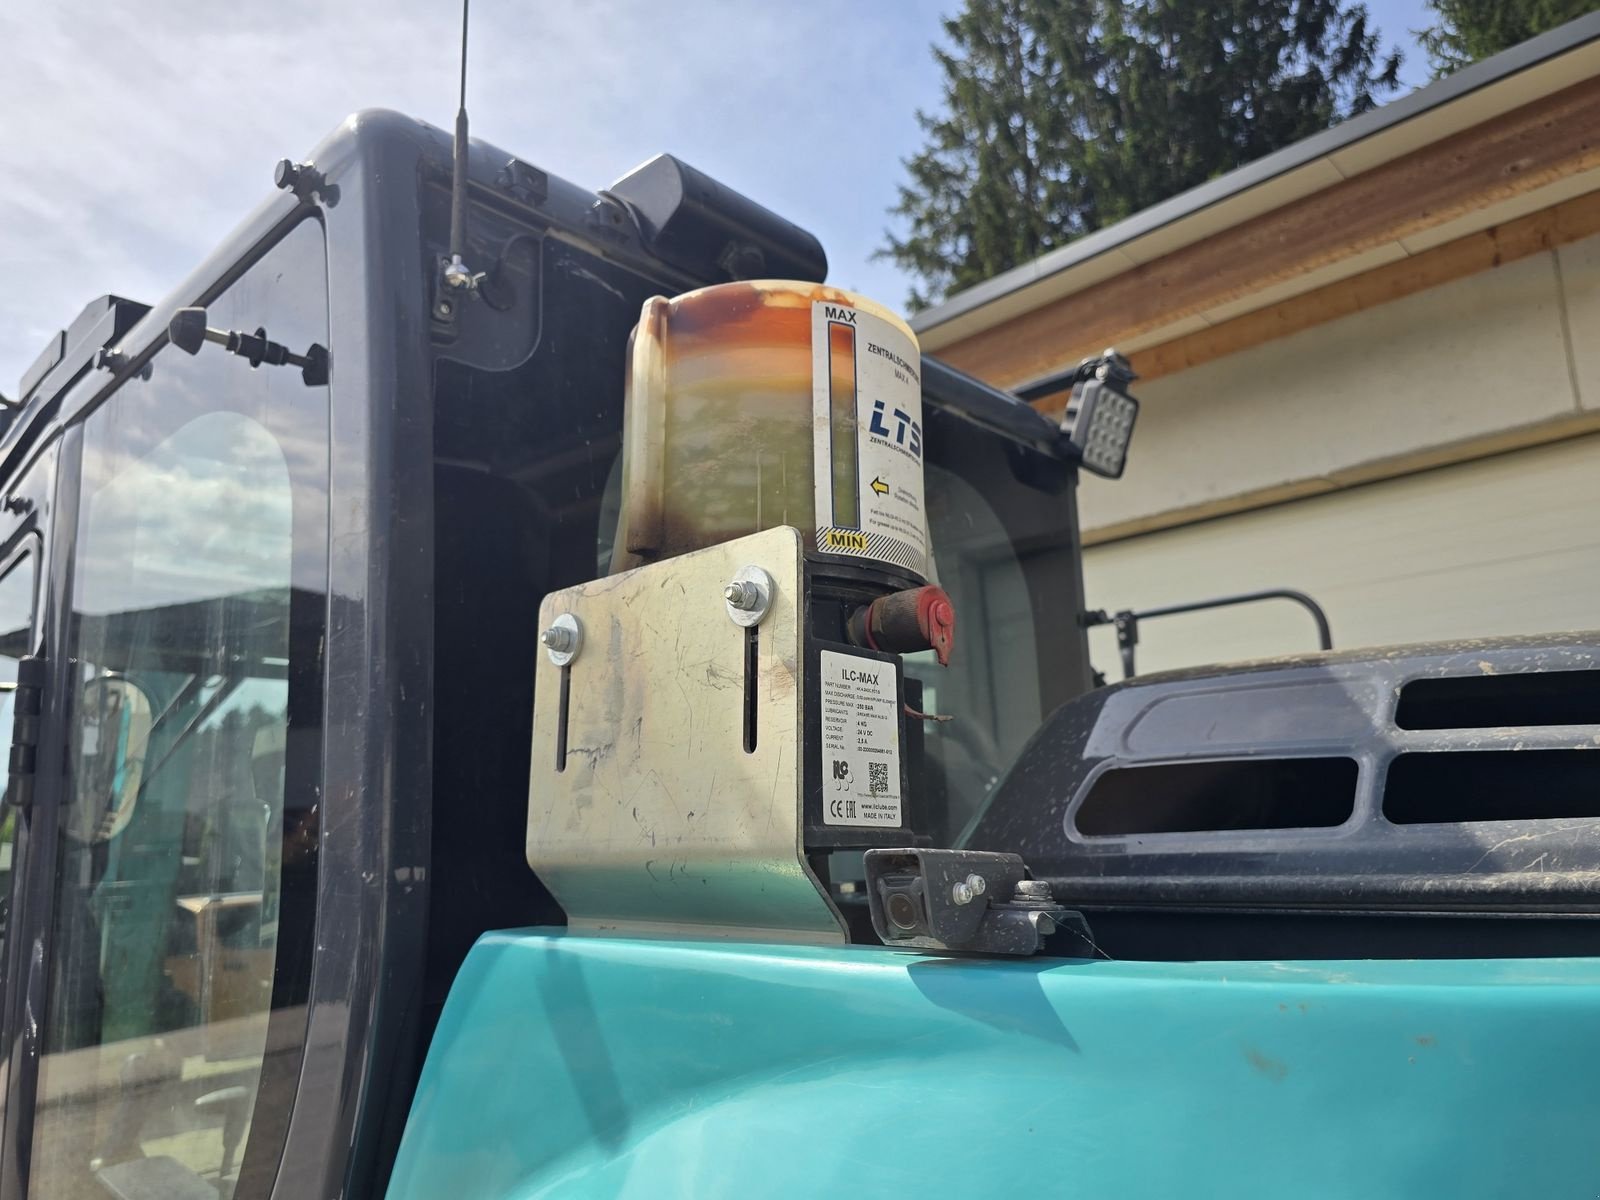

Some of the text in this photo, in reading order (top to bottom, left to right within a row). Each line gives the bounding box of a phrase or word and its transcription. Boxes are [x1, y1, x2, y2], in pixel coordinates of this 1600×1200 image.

[825, 306, 857, 325] MAX
[869, 399, 921, 459] LTS
[831, 533, 863, 548] MIN
[842, 668, 879, 686] ILC-MAX
